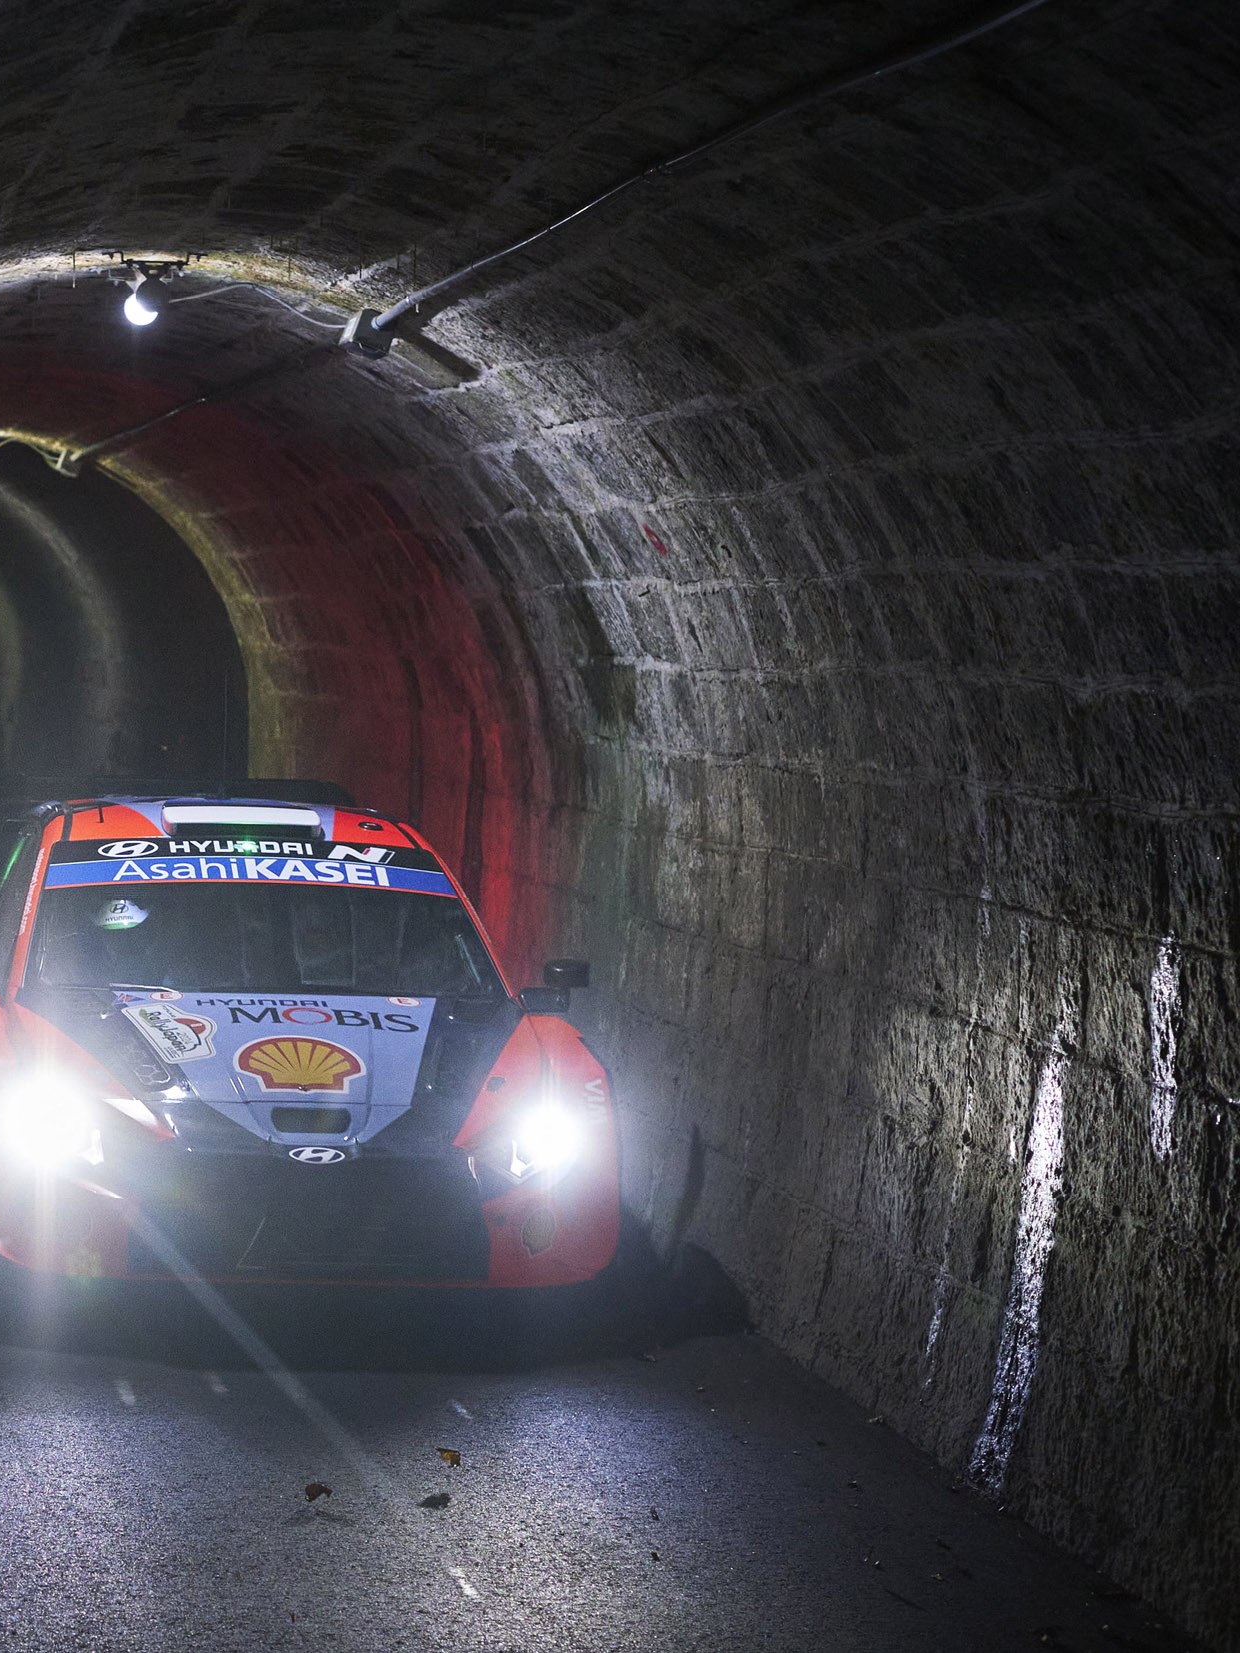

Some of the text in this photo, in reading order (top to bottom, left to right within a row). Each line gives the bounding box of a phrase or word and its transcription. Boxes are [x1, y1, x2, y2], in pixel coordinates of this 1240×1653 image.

[169, 841, 314, 855] HYUNDAI
[196, 998, 328, 1008] HYUNDAI
[228, 1007, 420, 1033] MOBIS
